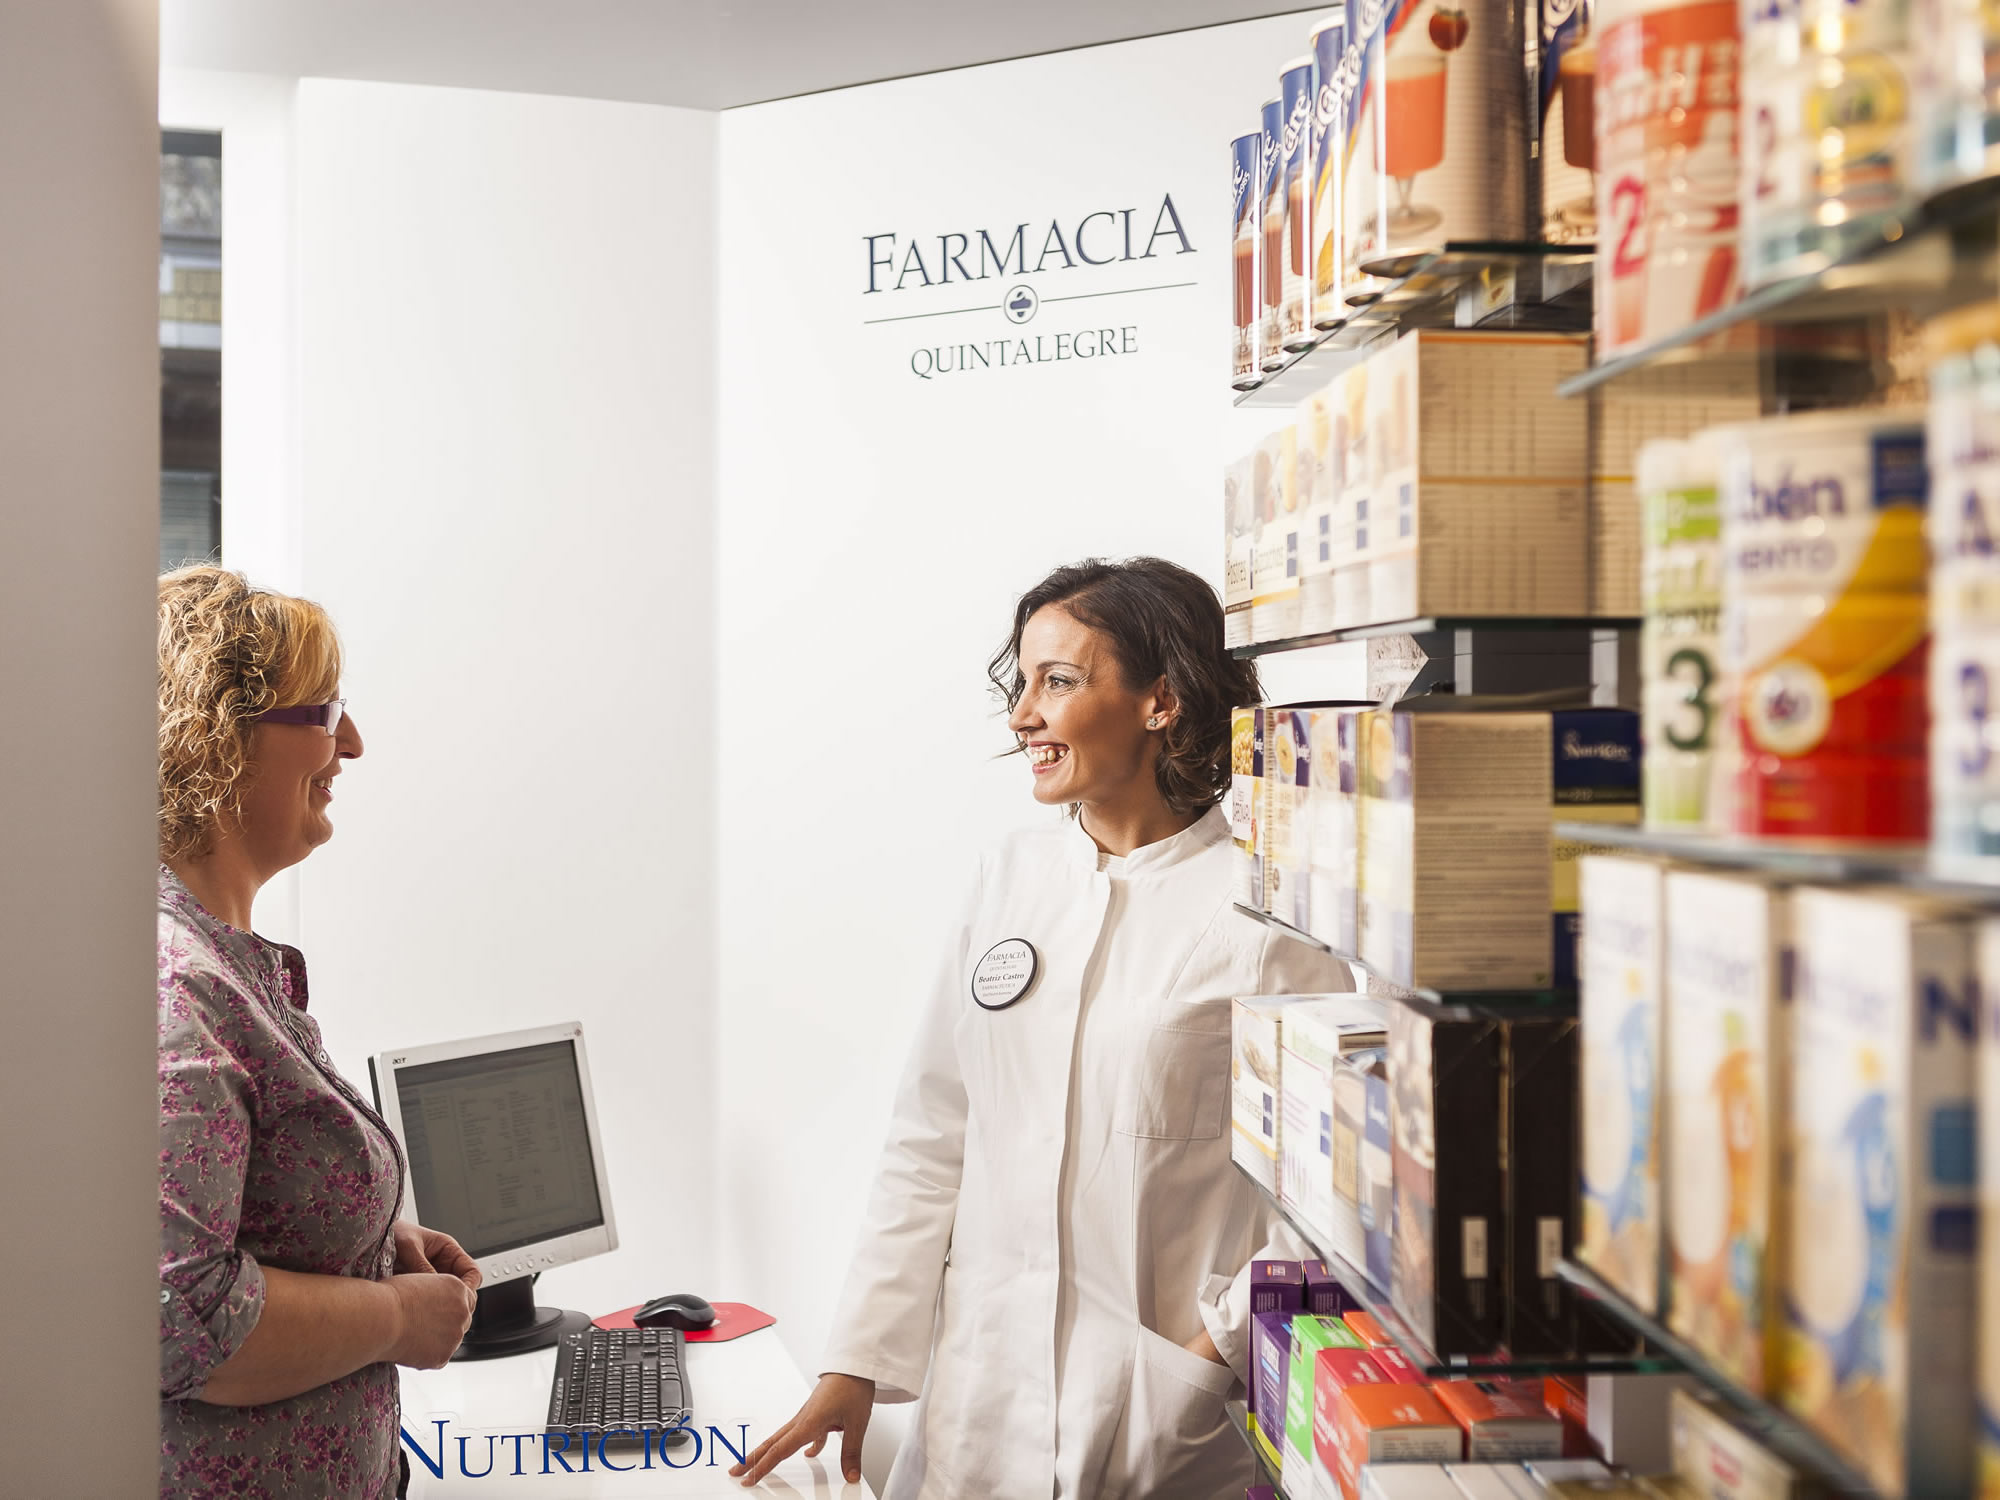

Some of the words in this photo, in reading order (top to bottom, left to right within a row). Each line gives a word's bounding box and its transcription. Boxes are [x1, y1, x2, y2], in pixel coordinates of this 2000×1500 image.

[862, 192, 1198, 295] FARMACIA
[910, 326, 1139, 380] QUINTALEGRE
[1664, 647, 1714, 754] 3
[978, 974, 1002, 983] Beatriz
[1002, 973, 1025, 981] Castro
[987, 951, 1026, 961] FARMACIA
[400, 1415, 751, 1481] NUTRICIÓN
